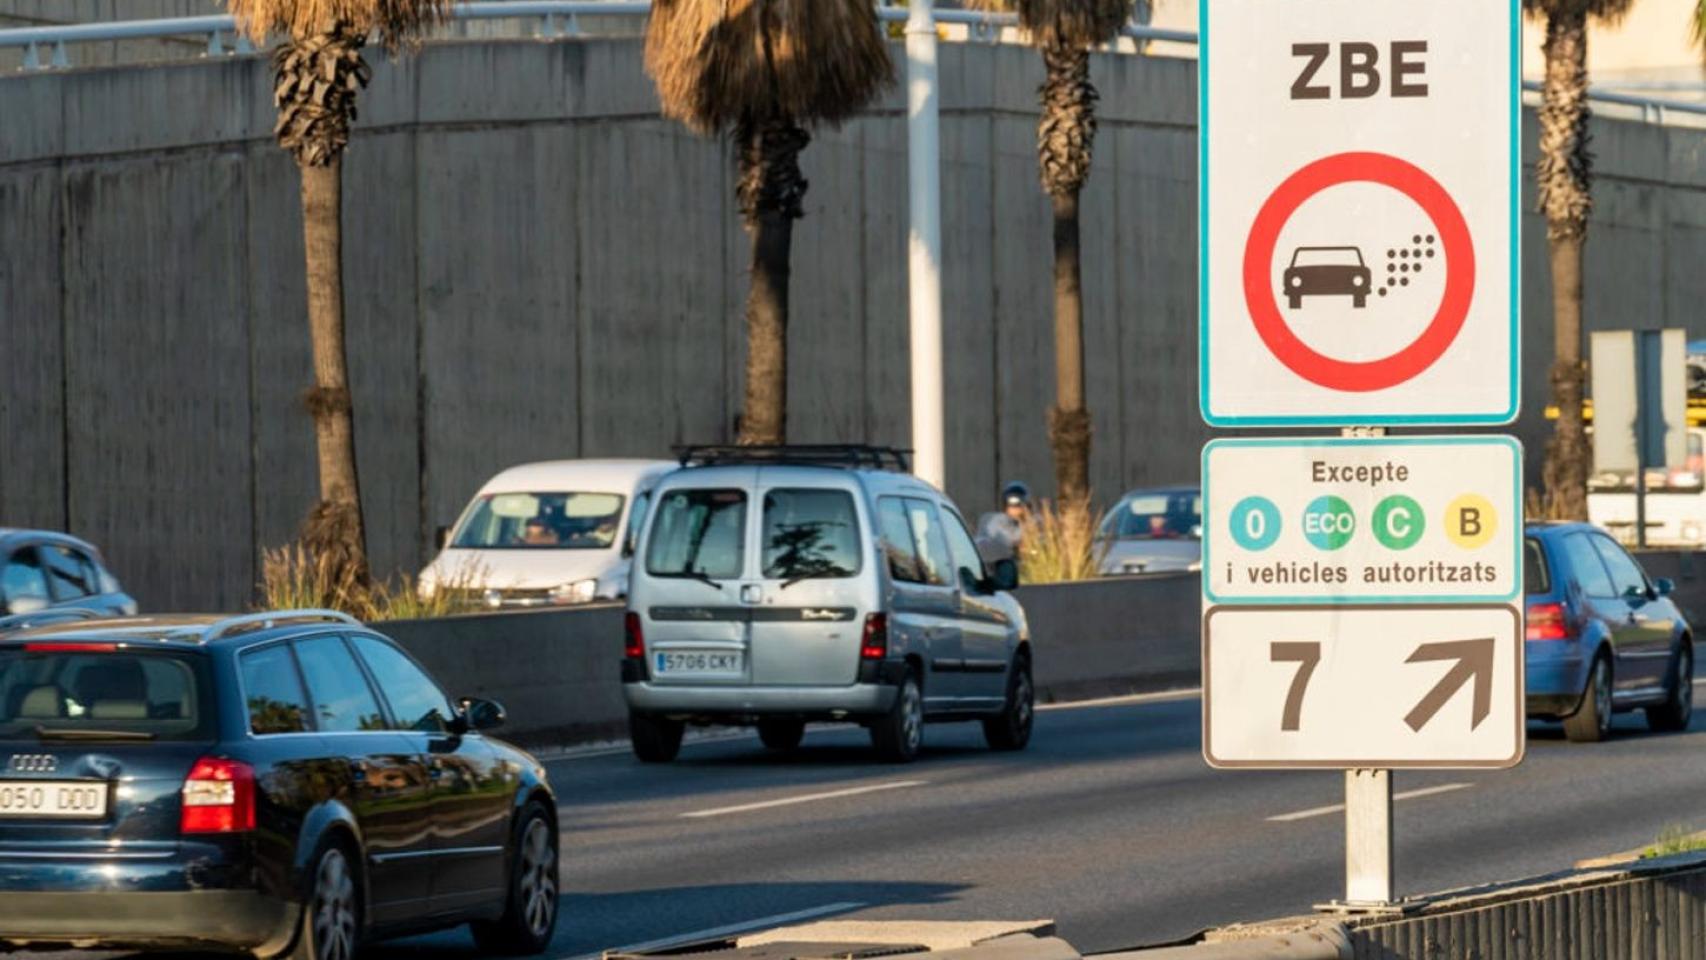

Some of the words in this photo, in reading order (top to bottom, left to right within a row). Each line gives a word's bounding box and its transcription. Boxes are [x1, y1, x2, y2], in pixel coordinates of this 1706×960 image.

[1290, 40, 1429, 99] ZBE
[1312, 461, 1409, 486] Excepte
[1305, 513, 1353, 533] ECO
[1386, 507, 1411, 537] C
[1460, 508, 1481, 536] B
[1226, 562, 1233, 583] i
[1248, 562, 1347, 583] vehicles
[1363, 561, 1496, 582] autoritzats
[709, 652, 738, 669] CKY
[1270, 641, 1321, 731] 7
